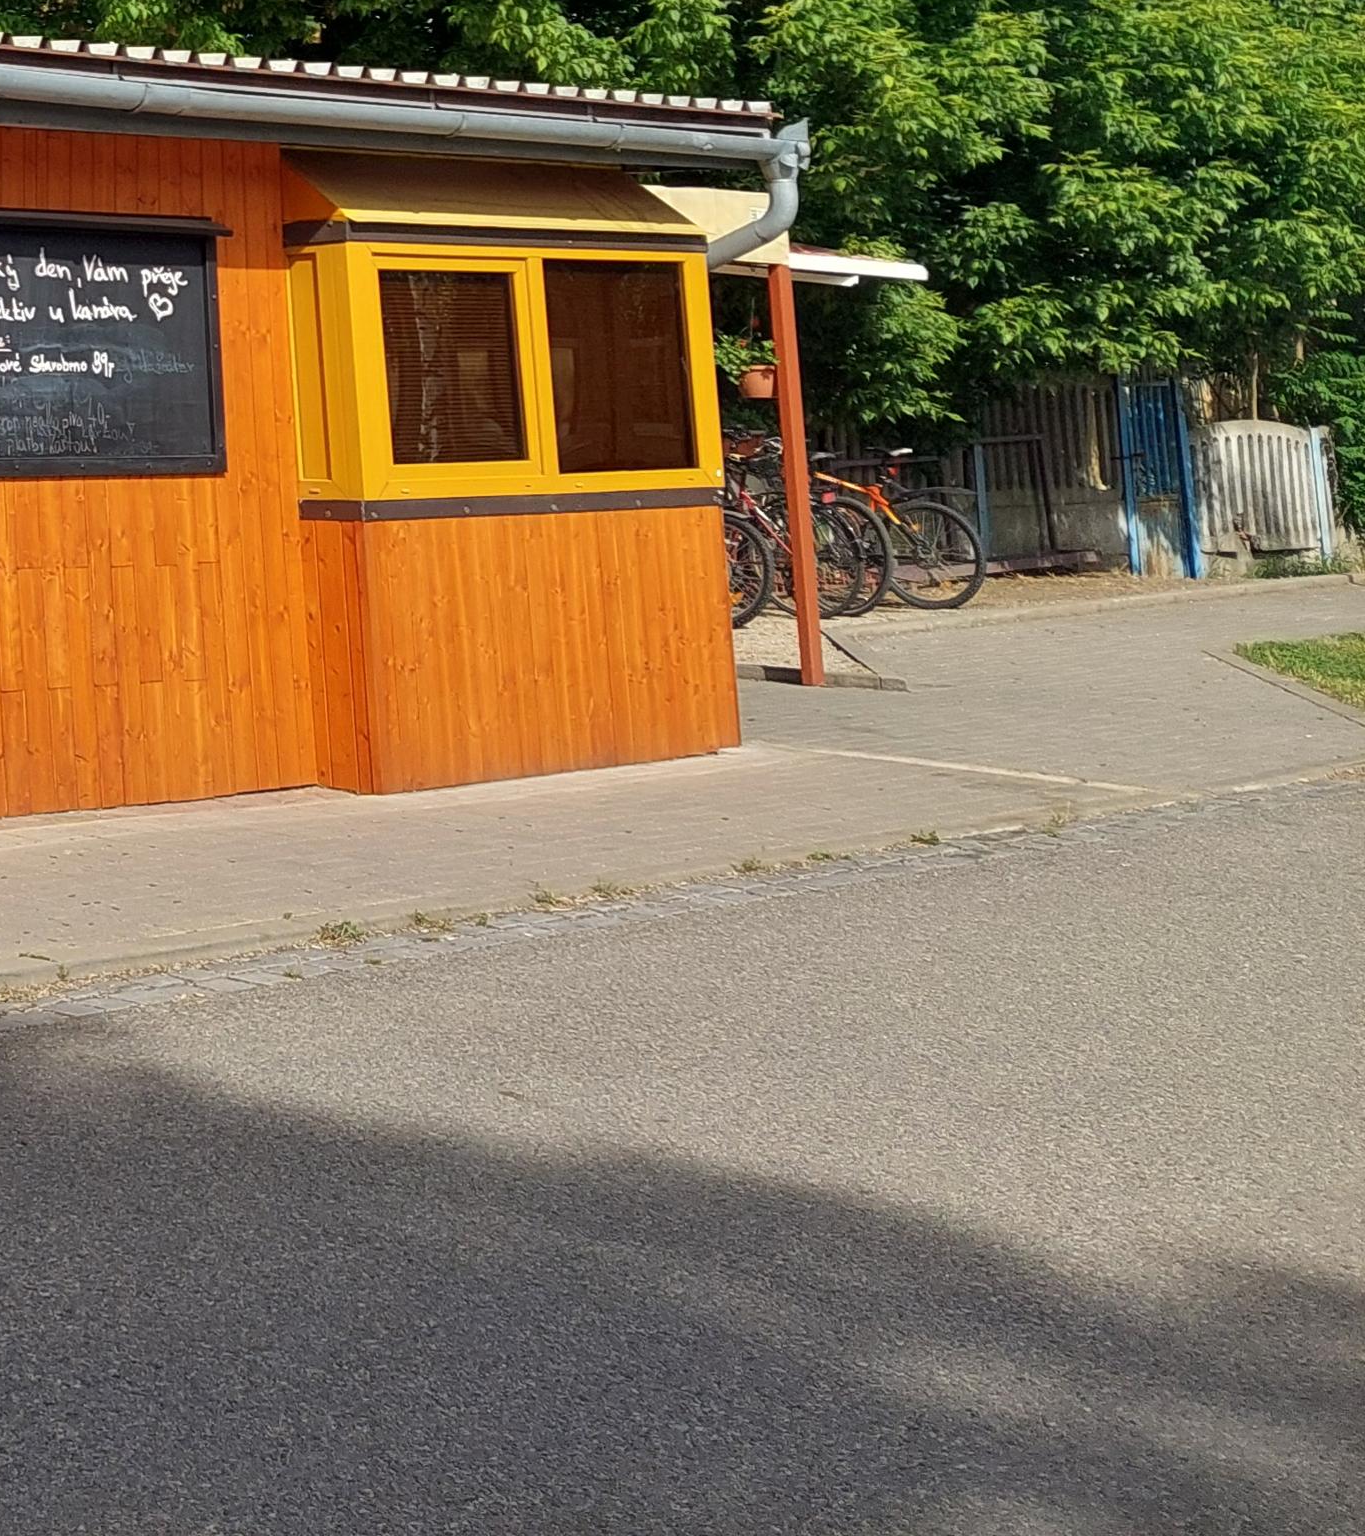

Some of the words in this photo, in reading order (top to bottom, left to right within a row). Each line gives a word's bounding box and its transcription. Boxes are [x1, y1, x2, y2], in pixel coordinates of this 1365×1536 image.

[83, 254, 129, 283] Vám
[141, 267, 189, 297] přeje
[48, 304, 65, 324] u
